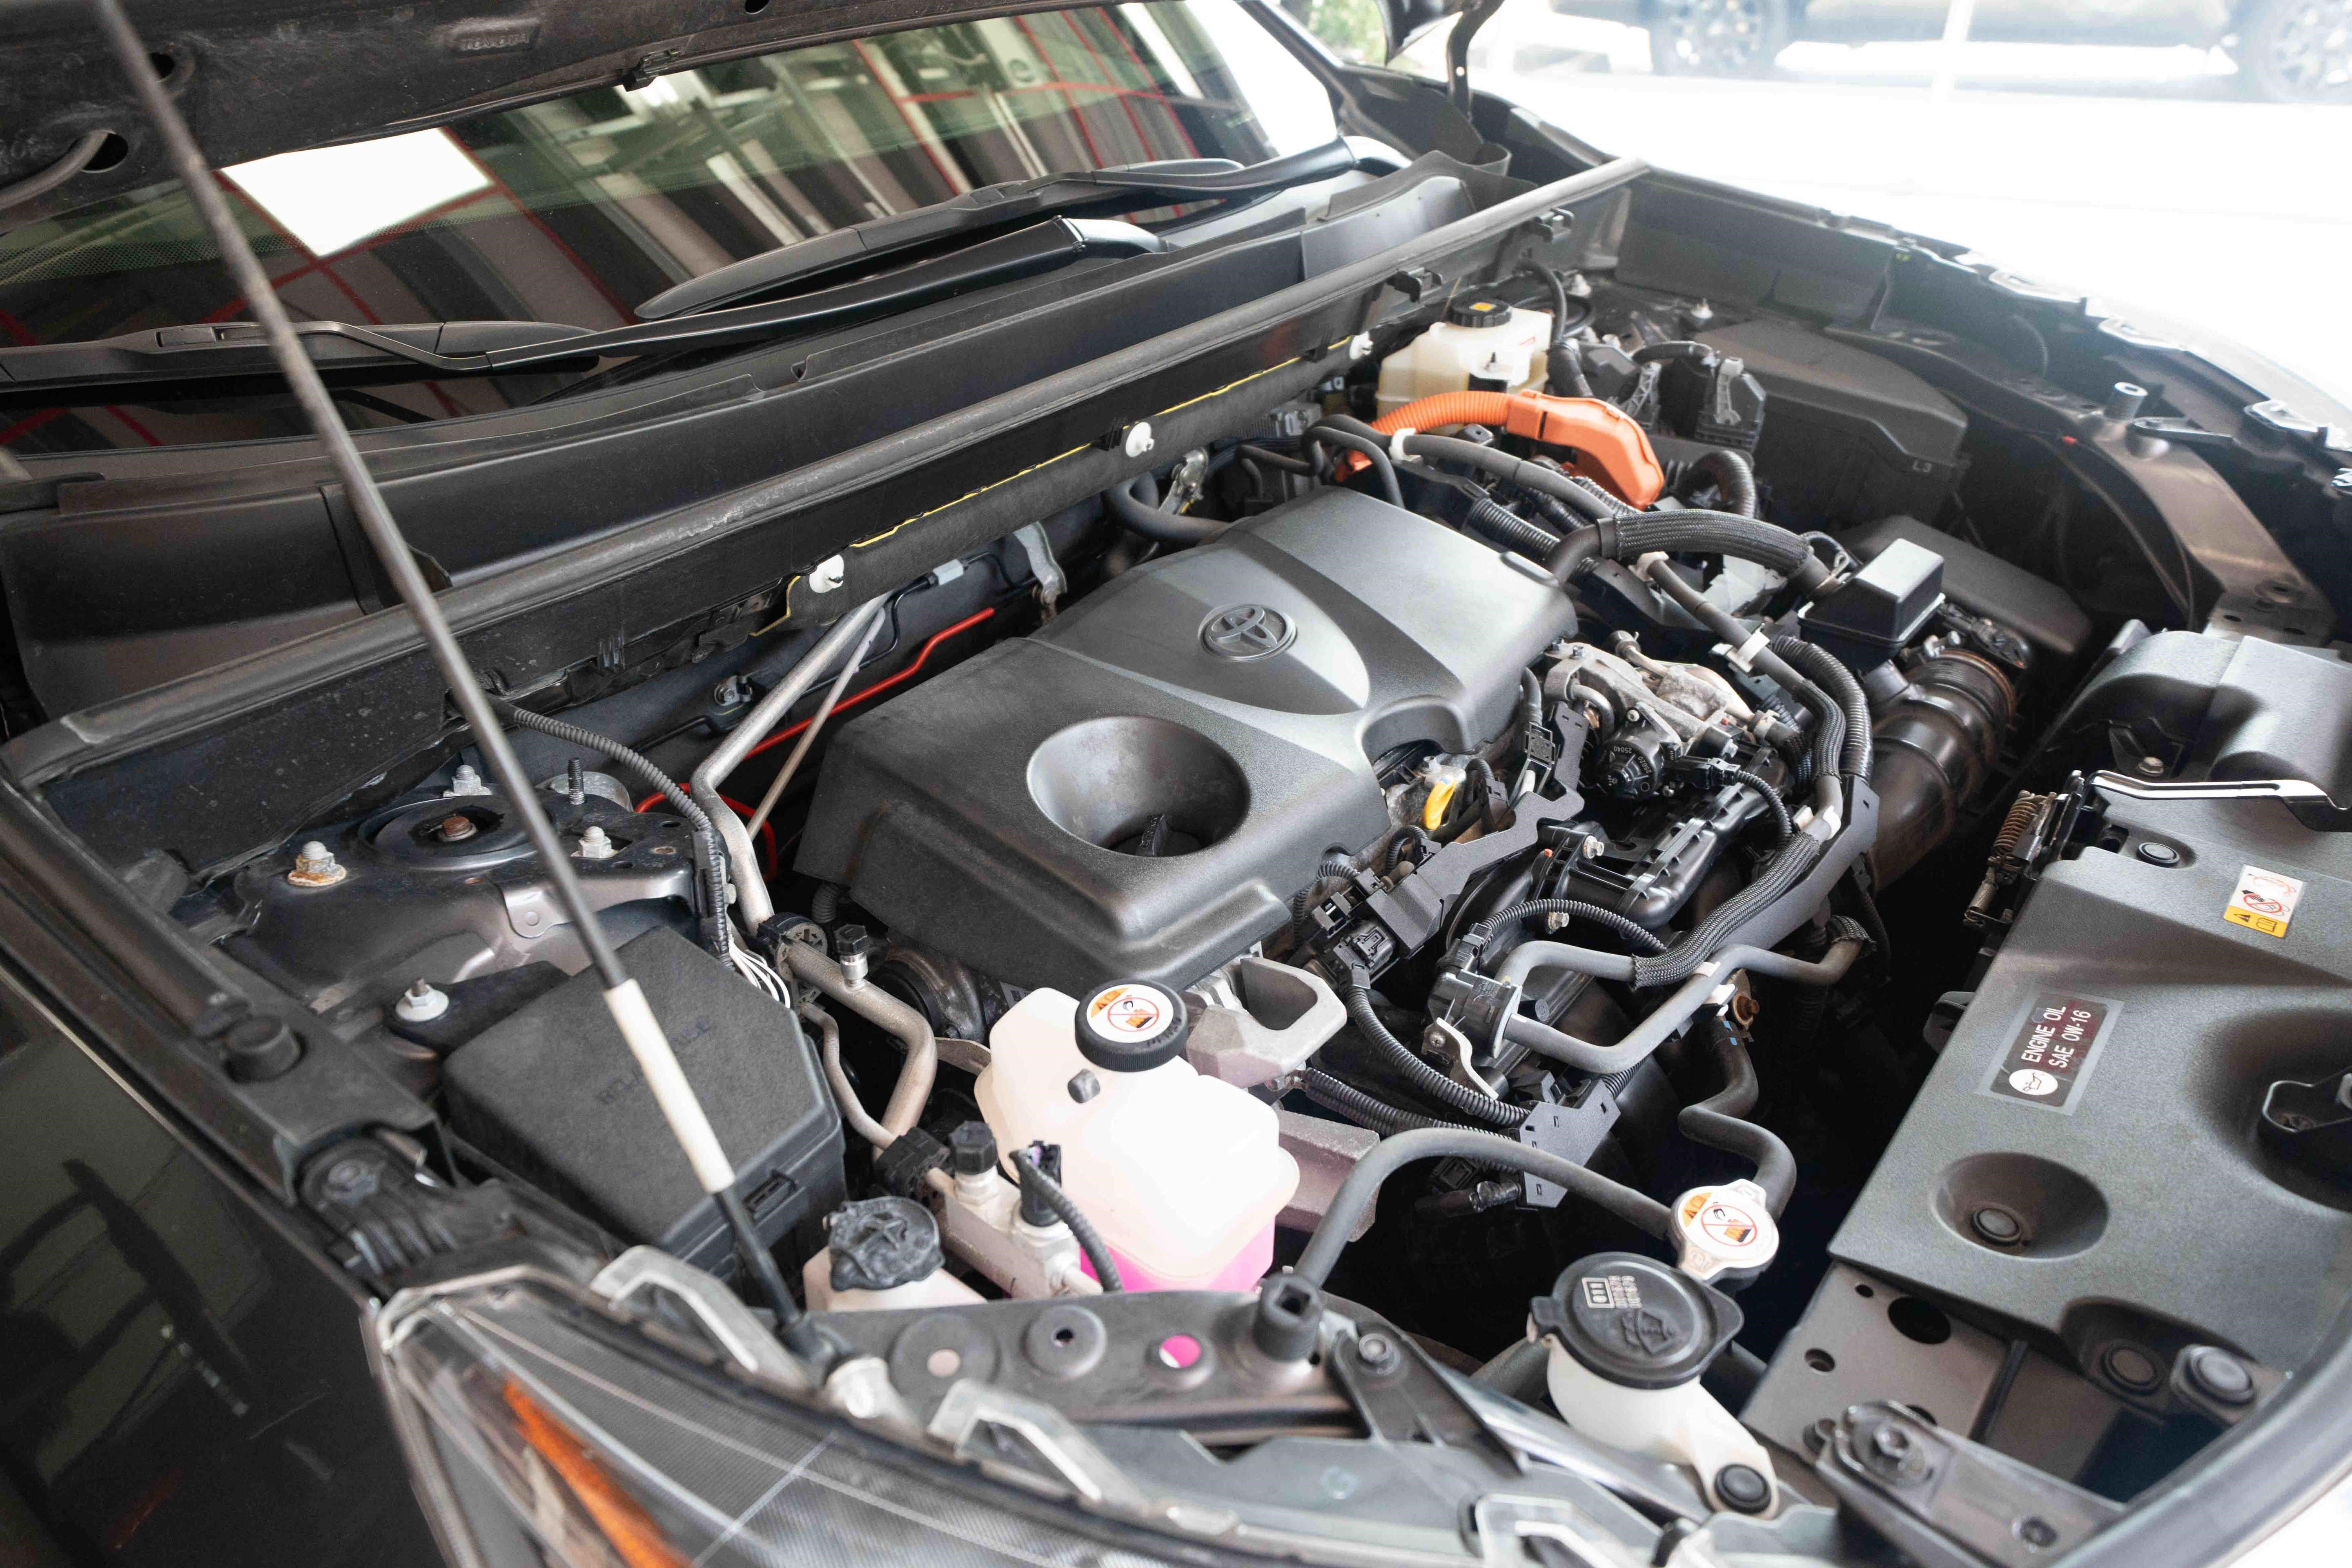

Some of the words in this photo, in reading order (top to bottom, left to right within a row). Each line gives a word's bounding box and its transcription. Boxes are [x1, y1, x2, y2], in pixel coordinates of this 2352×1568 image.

[2021, 1024, 2057, 1063] ENGINE
[2043, 1006, 2066, 1022] OIL
[2048, 1045, 2075, 1069] SAE
